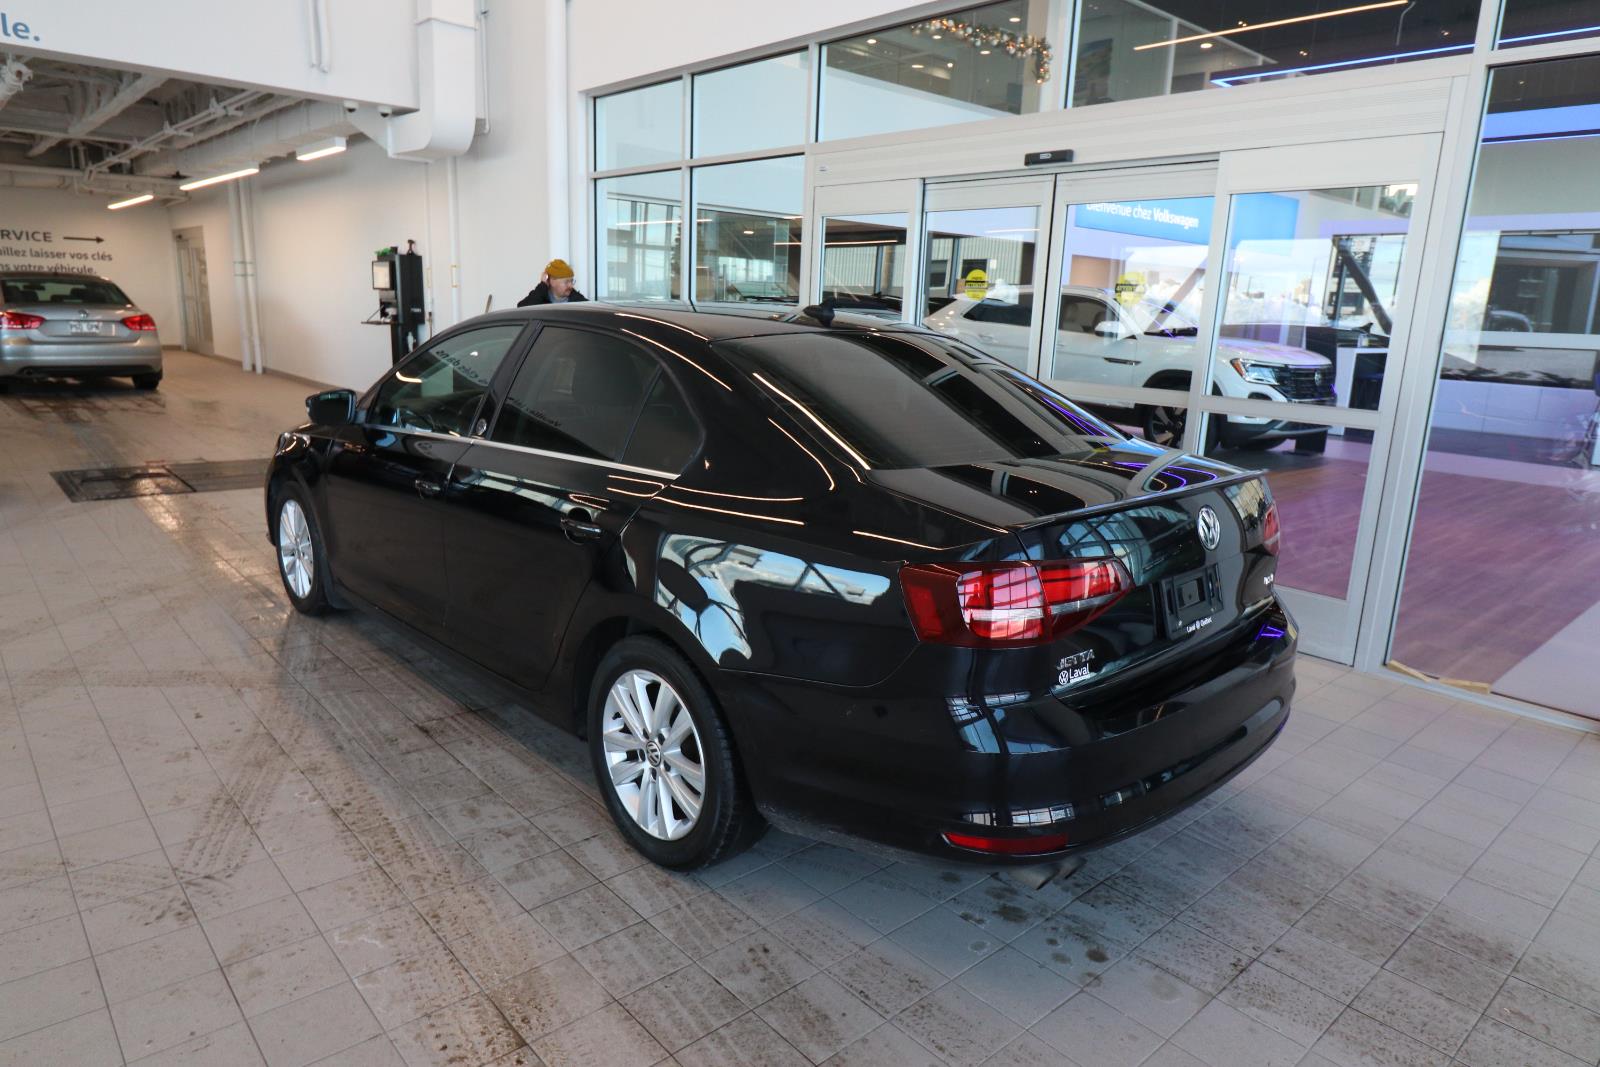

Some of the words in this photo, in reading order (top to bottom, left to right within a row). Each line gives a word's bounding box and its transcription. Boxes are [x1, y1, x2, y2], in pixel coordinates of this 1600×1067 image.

[1133, 204, 1152, 221] chez
[1153, 207, 1199, 230] Volkswagen
[0, 247, 27, 258] illez
[30, 248, 66, 260] laisser
[70, 252, 88, 261] vos
[91, 250, 113, 262] clés
[13, 263, 44, 272] votre
[1056, 649, 1096, 671] JETTA
[1069, 662, 1090, 679] Laval
